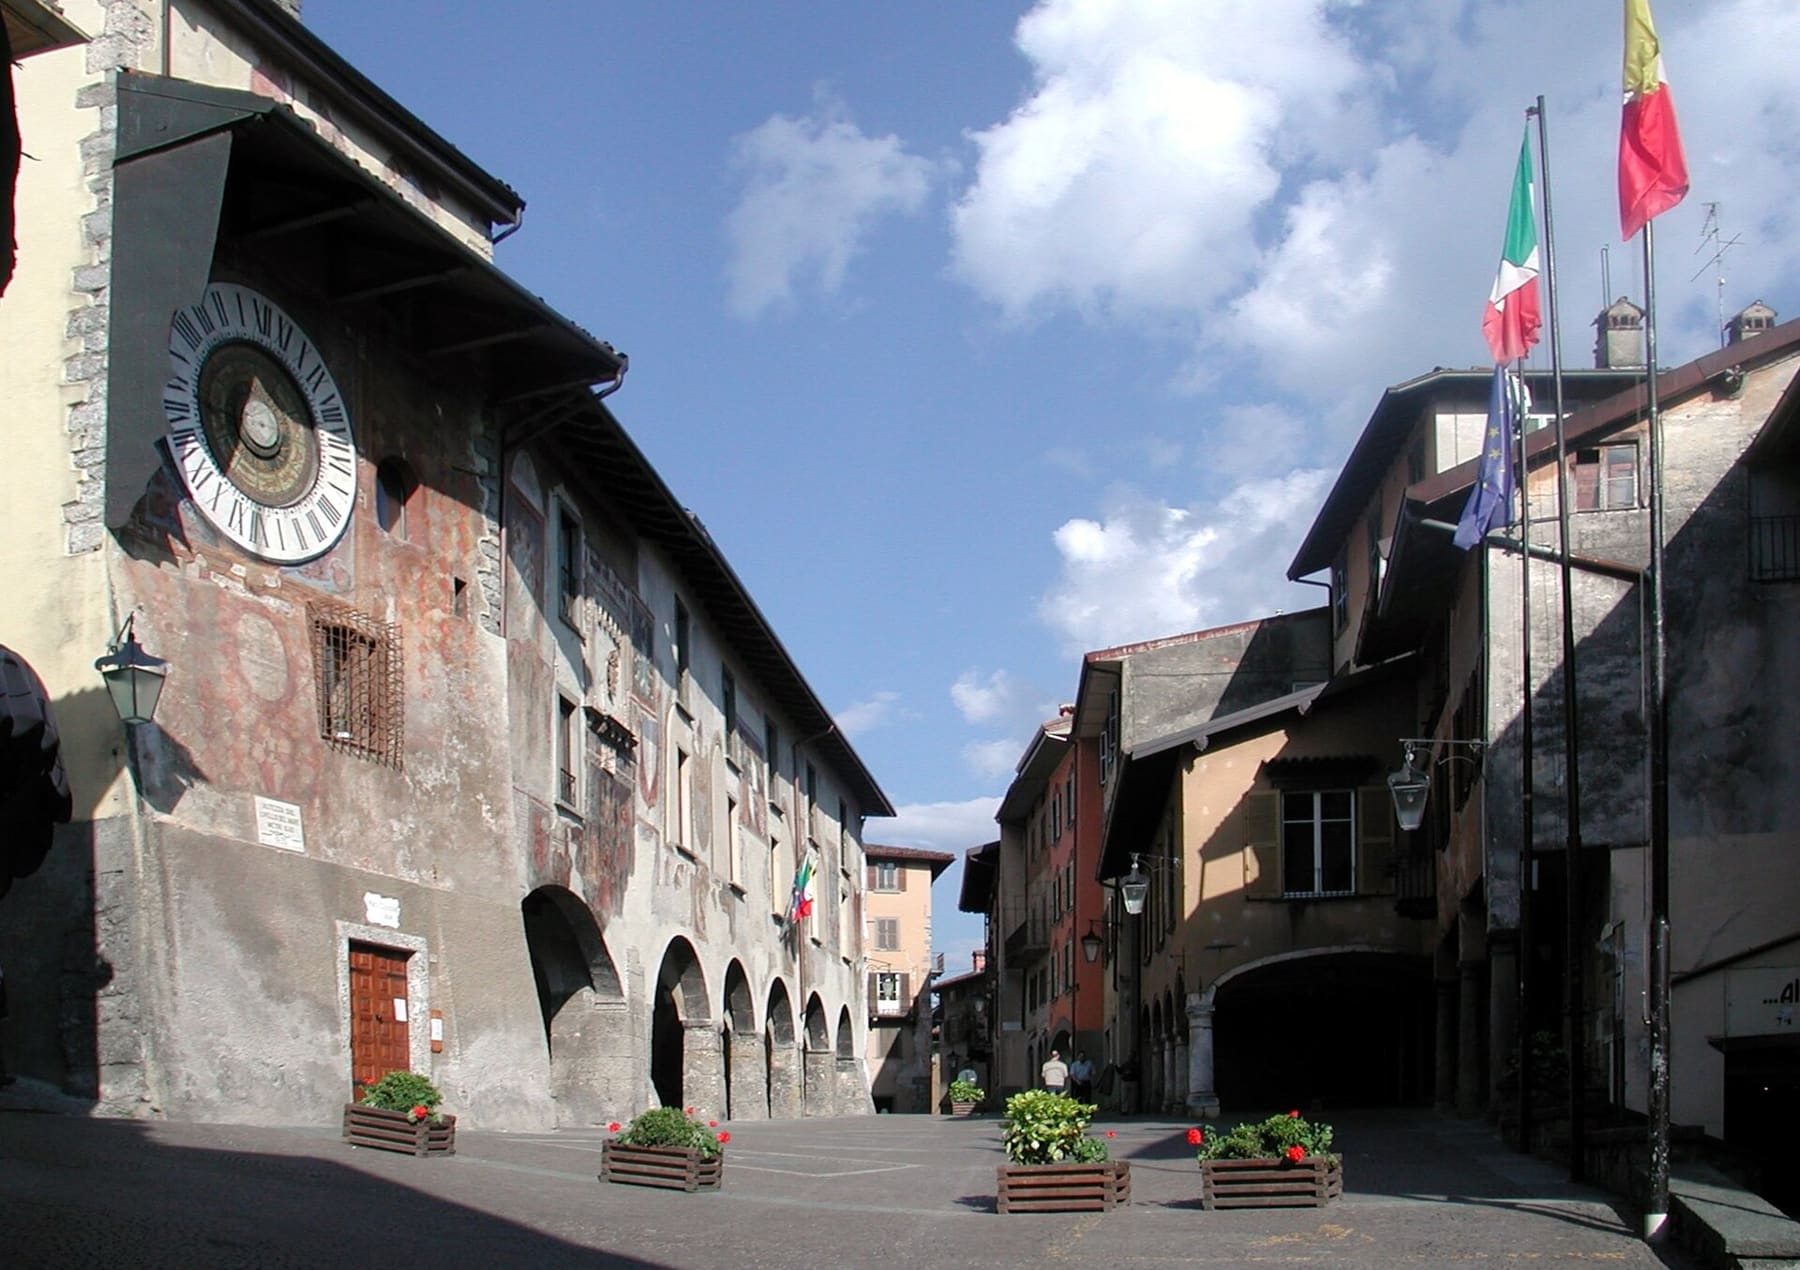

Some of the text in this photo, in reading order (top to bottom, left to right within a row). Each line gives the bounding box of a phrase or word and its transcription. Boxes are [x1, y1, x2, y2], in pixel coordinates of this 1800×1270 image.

[252, 297, 272, 339] XII
[318, 393, 345, 423] VIII
[315, 492, 343, 528] IIII
